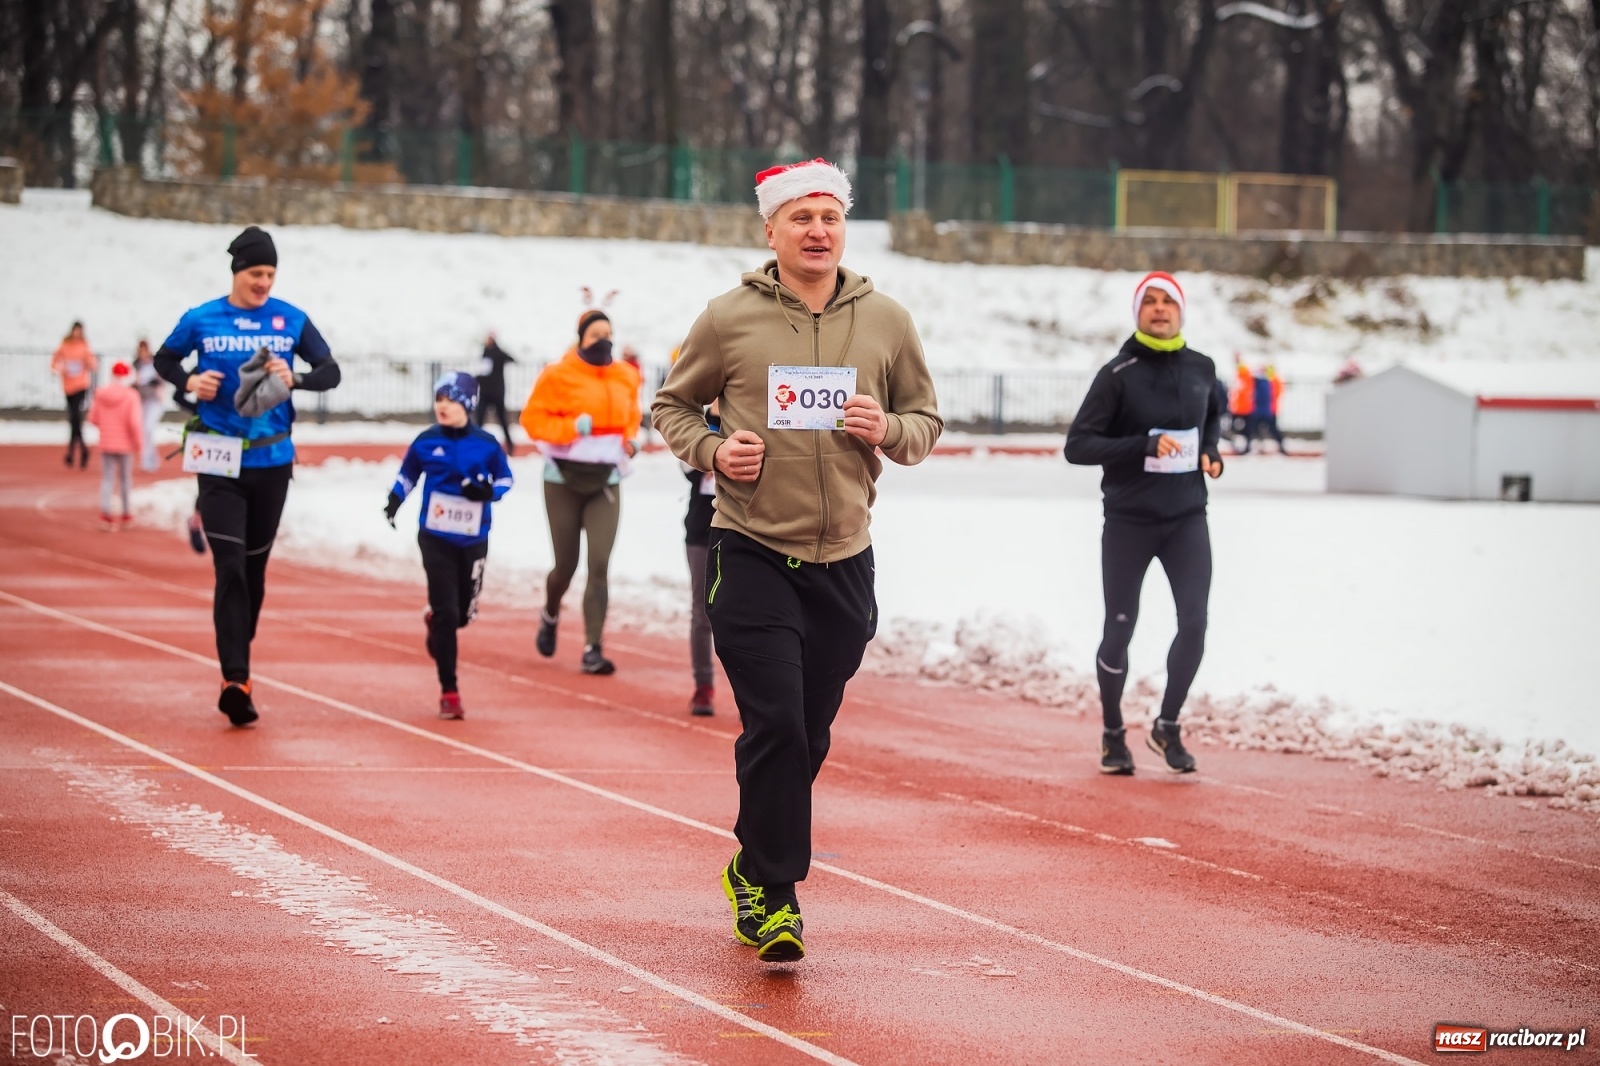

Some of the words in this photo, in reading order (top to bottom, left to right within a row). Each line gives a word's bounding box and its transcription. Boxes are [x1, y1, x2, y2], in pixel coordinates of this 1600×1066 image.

[202, 335, 294, 353] RUNNERS
[800, 388, 847, 409] 030
[206, 448, 231, 462] 174
[447, 508, 473, 523] 189
